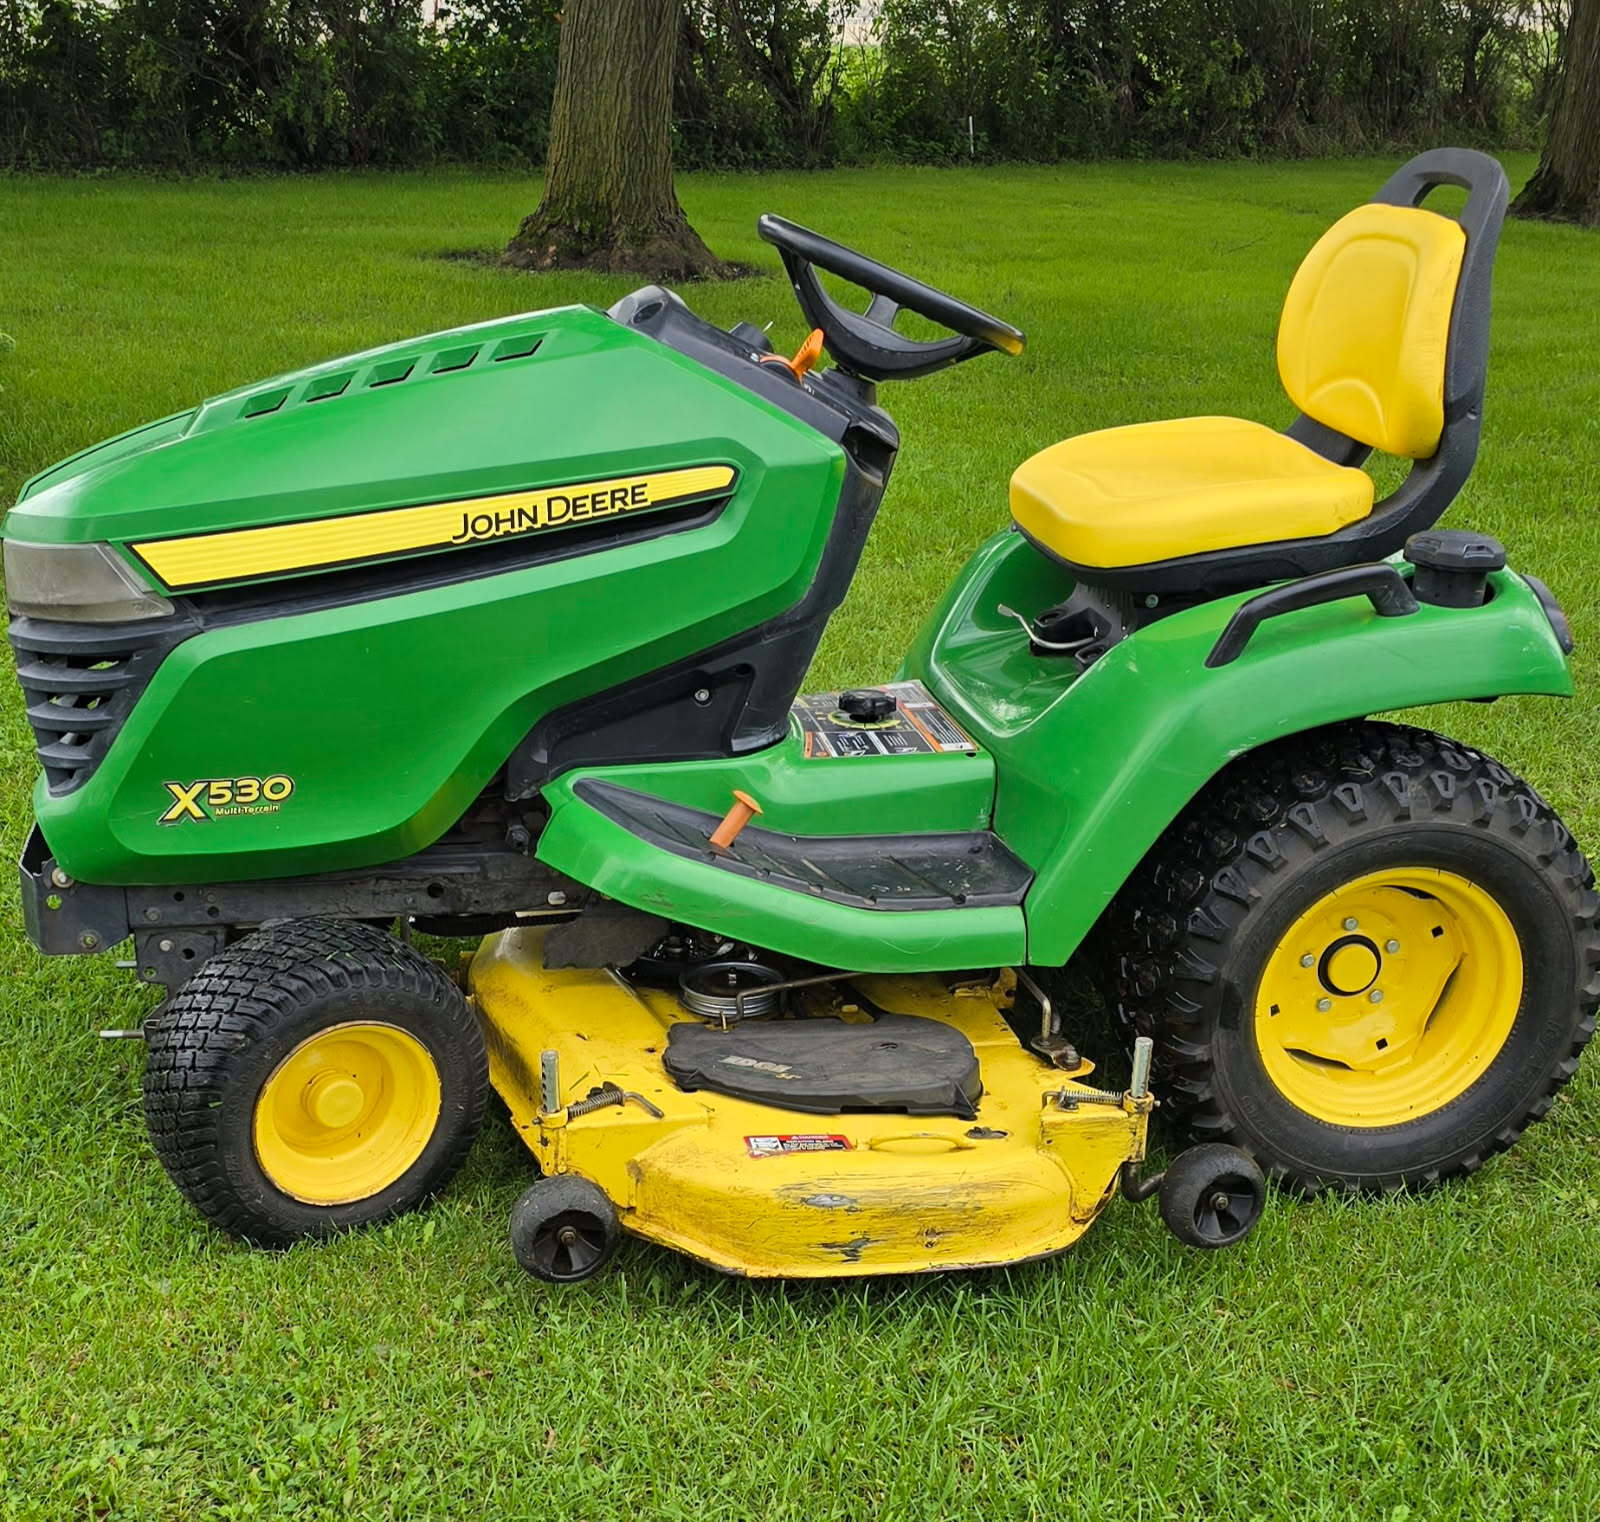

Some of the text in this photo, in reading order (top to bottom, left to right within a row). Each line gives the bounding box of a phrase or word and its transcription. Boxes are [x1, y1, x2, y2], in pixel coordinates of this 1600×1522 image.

[451, 483, 649, 541] JOHN DEERE
[159, 775, 294, 822] X530
[215, 804, 279, 816] Multi-Terrain
